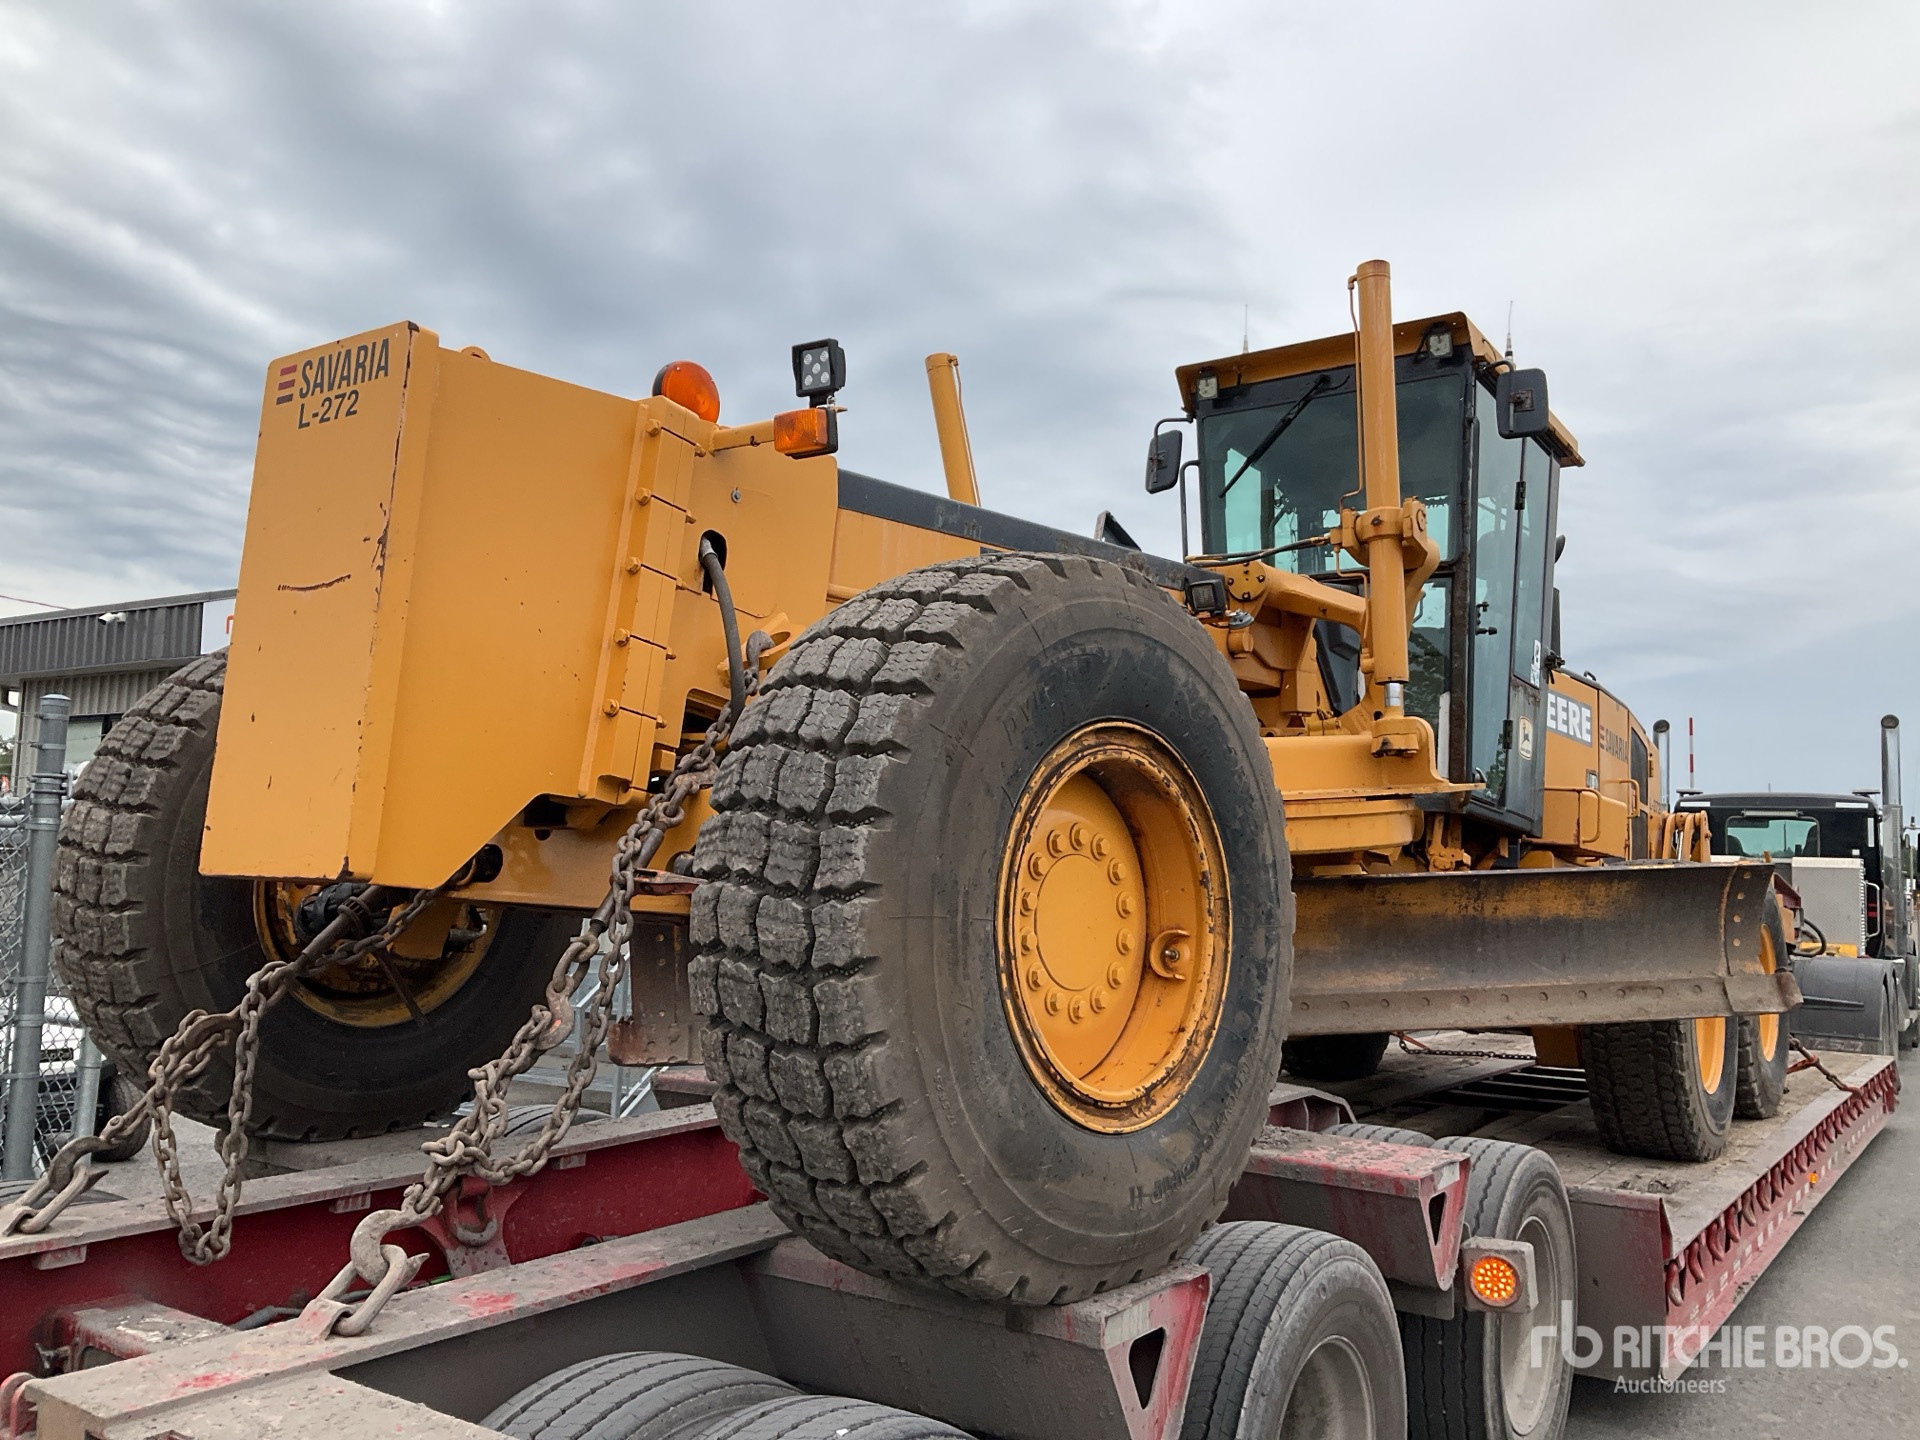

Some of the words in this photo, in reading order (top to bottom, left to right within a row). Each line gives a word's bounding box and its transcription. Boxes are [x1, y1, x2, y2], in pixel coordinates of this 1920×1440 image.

[299, 338, 389, 399] SAVARIA
[298, 389, 359, 430] L-272
[1605, 728, 1628, 763] SAVARIA
